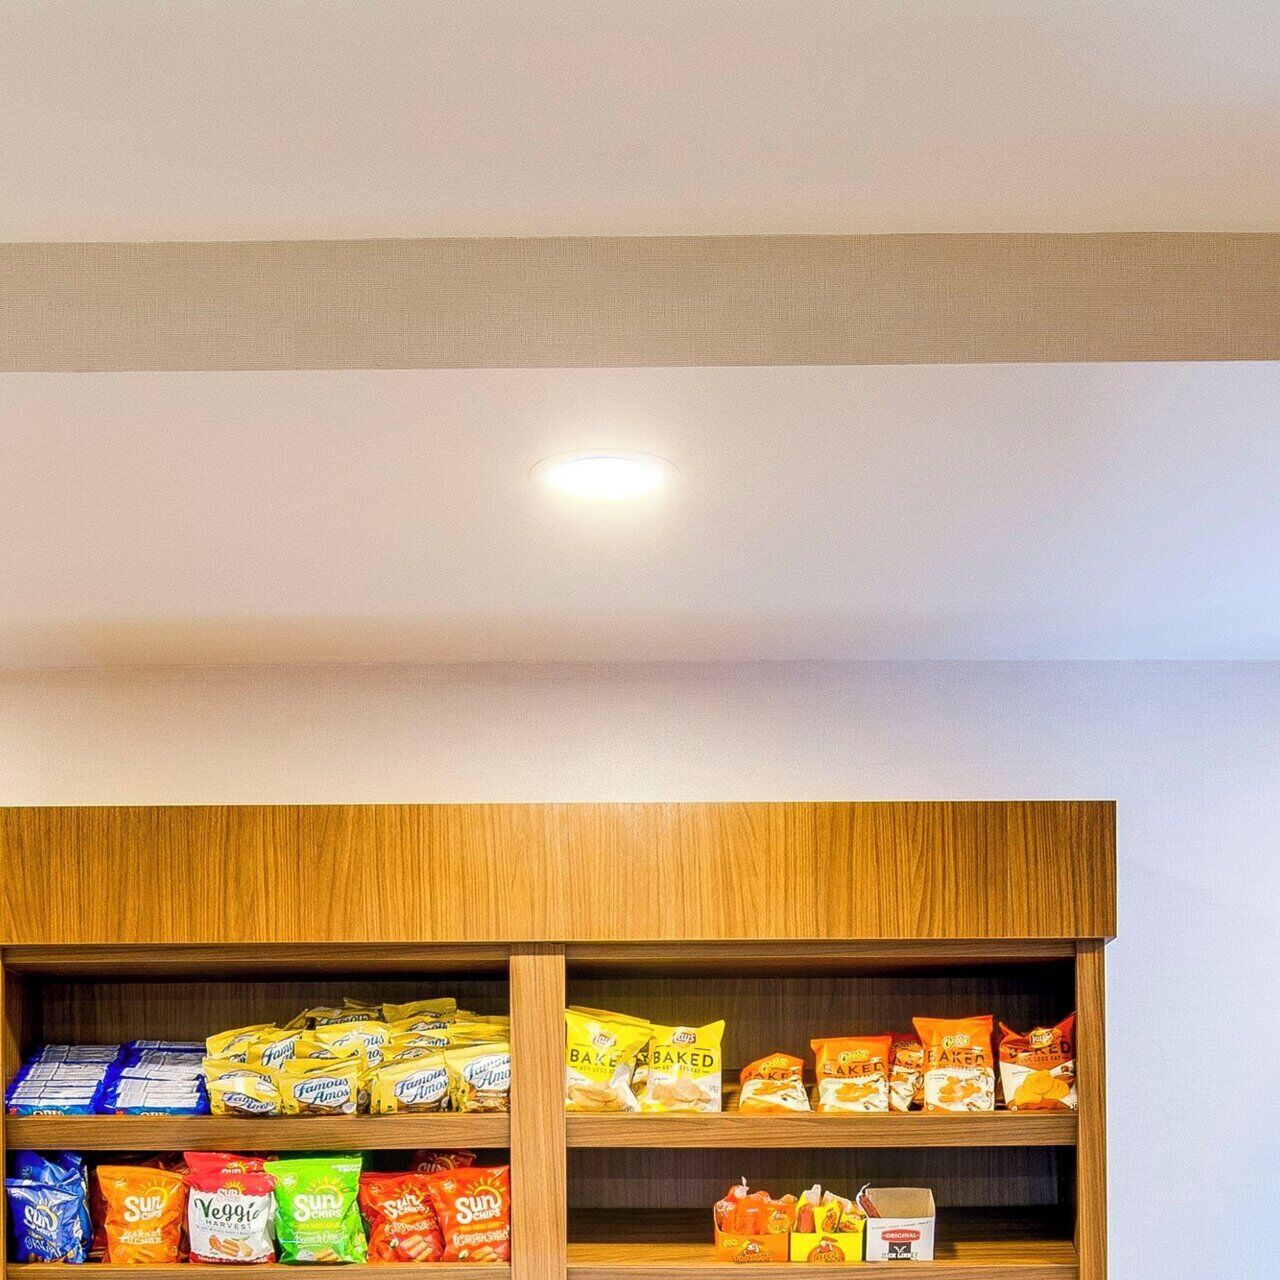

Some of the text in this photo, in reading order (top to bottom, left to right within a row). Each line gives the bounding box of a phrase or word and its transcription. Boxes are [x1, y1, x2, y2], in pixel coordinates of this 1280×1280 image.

[570, 1049, 617, 1067] BAKE
[653, 1050, 714, 1068] BAKED
[293, 1078, 349, 1098] Famous
[395, 1068, 447, 1097] Famous
[486, 1068, 511, 1088] Amo
[310, 1087, 350, 1105] Amos
[407, 1080, 448, 1103] Amos
[123, 1195, 166, 1223] Sun
[294, 1194, 344, 1222] Sun
[311, 1209, 342, 1220] CHIPS
[383, 1194, 421, 1219] Sun
[456, 1195, 504, 1225] Sun
[472, 1207, 501, 1221] CHIPS
